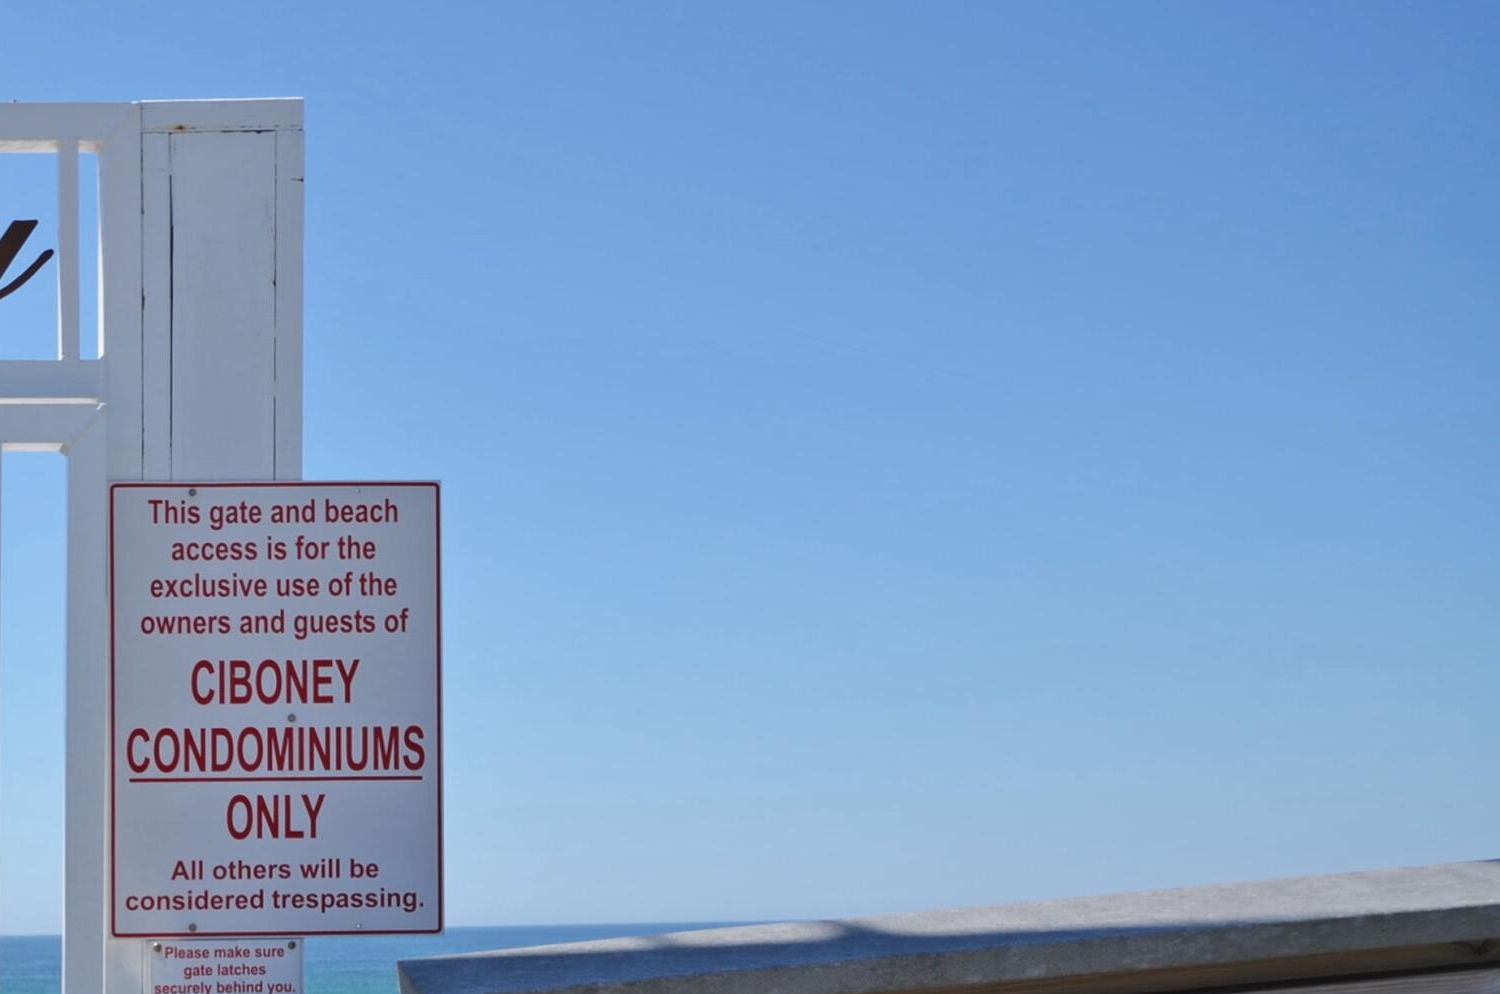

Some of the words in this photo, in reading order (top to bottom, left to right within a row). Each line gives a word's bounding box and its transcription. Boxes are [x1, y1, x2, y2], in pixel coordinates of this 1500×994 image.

[148, 500, 200, 524] This
[209, 501, 262, 530] gate
[271, 499, 315, 523] and
[325, 499, 398, 523] beach
[172, 541, 258, 560] access
[267, 536, 287, 560] is
[295, 536, 330, 560] for
[338, 536, 376, 559] the
[150, 573, 267, 598] exclusive
[276, 578, 320, 596] use
[328, 572, 353, 596] of
[359, 572, 397, 595] the
[140, 615, 231, 634] owners
[239, 609, 285, 633] and
[293, 609, 376, 640] guests
[384, 608, 409, 632] of
[191, 659, 360, 705] CIBONEY
[127, 724, 425, 773] CONDOMINIUMS
[226, 794, 325, 840] ONLY
[171, 860, 203, 880] All
[212, 860, 291, 880] others
[300, 858, 341, 878] will
[350, 859, 379, 878] be
[125, 889, 264, 911] considered
[272, 888, 424, 913] trespassing.
[164, 947, 209, 959] Please
[214, 946, 250, 957] make
[255, 947, 284, 957] sure
[184, 966, 213, 979] gate
[218, 964, 266, 975] latches
[217, 981, 263, 993] behind
[267, 983, 296, 994] you.
